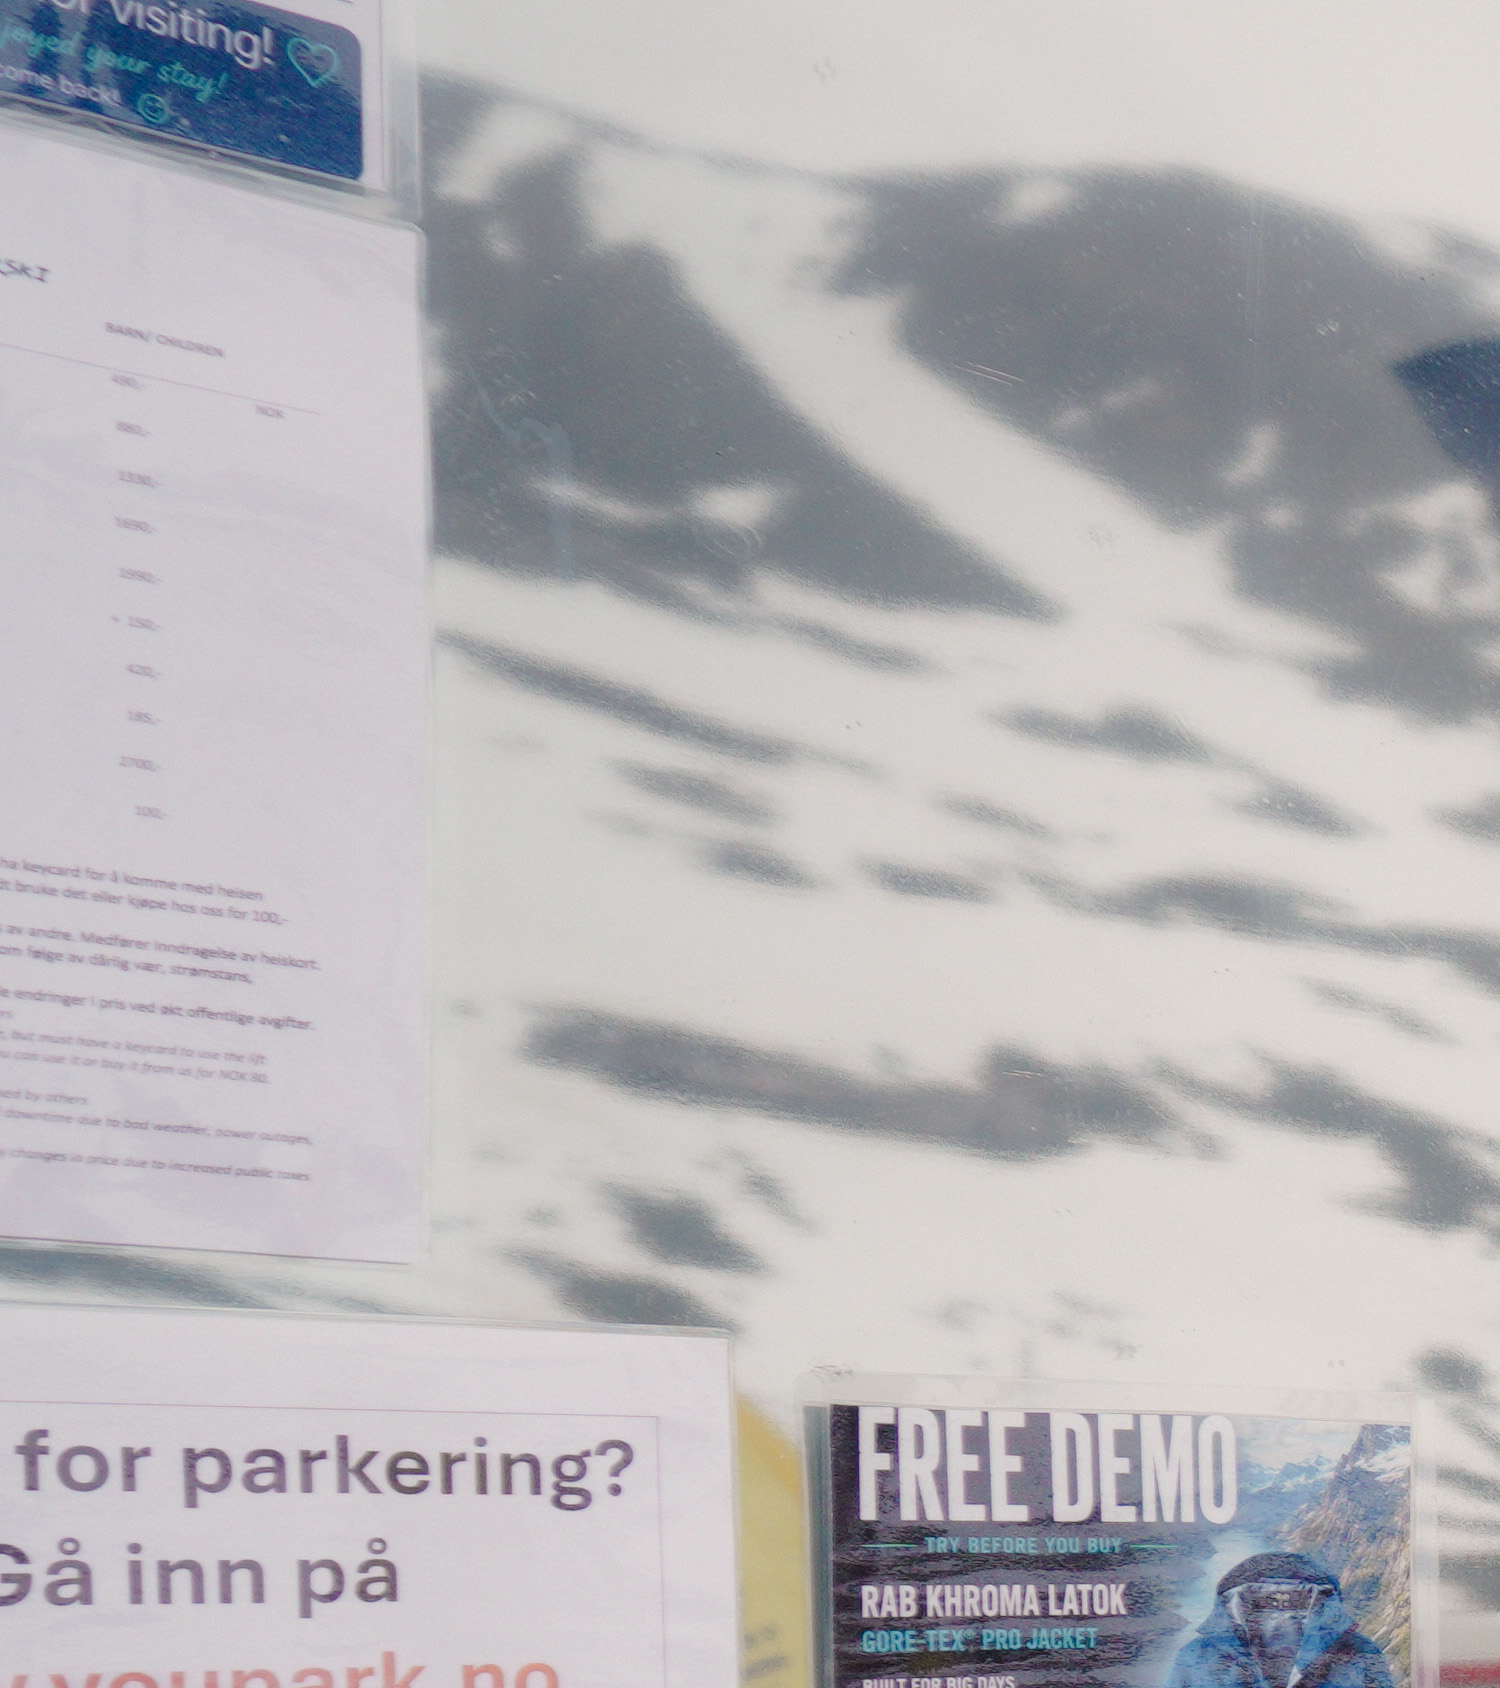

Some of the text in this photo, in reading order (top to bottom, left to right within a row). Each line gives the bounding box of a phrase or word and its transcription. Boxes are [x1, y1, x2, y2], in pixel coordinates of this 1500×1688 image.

[110, 0, 275, 70] visiting!
[155, 333, 225, 358] CHILDREN
[23, 859, 81, 877] keycard
[85, 867, 106, 881] for
[124, 873, 177, 891] komme
[218, 885, 264, 900] heisen
[171, 900, 197, 913] hos
[200, 905, 224, 917] oss
[228, 906, 248, 919] for
[7, 925, 24, 935] av
[241, 952, 257, 962] av
[16, 1430, 635, 1511] for parkering?
[857, 1405, 1238, 1525] FREE DEMO
[924, 1536, 1123, 1554] TRY BEFORE YOU BUY
[128, 1543, 266, 1605] inn
[298, 1537, 400, 1619] på
[860, 1582, 1128, 1619] RAB KHROMA LATOK
[981, 1627, 1023, 1651] PRO
[1026, 1626, 1099, 1651] JACKET
